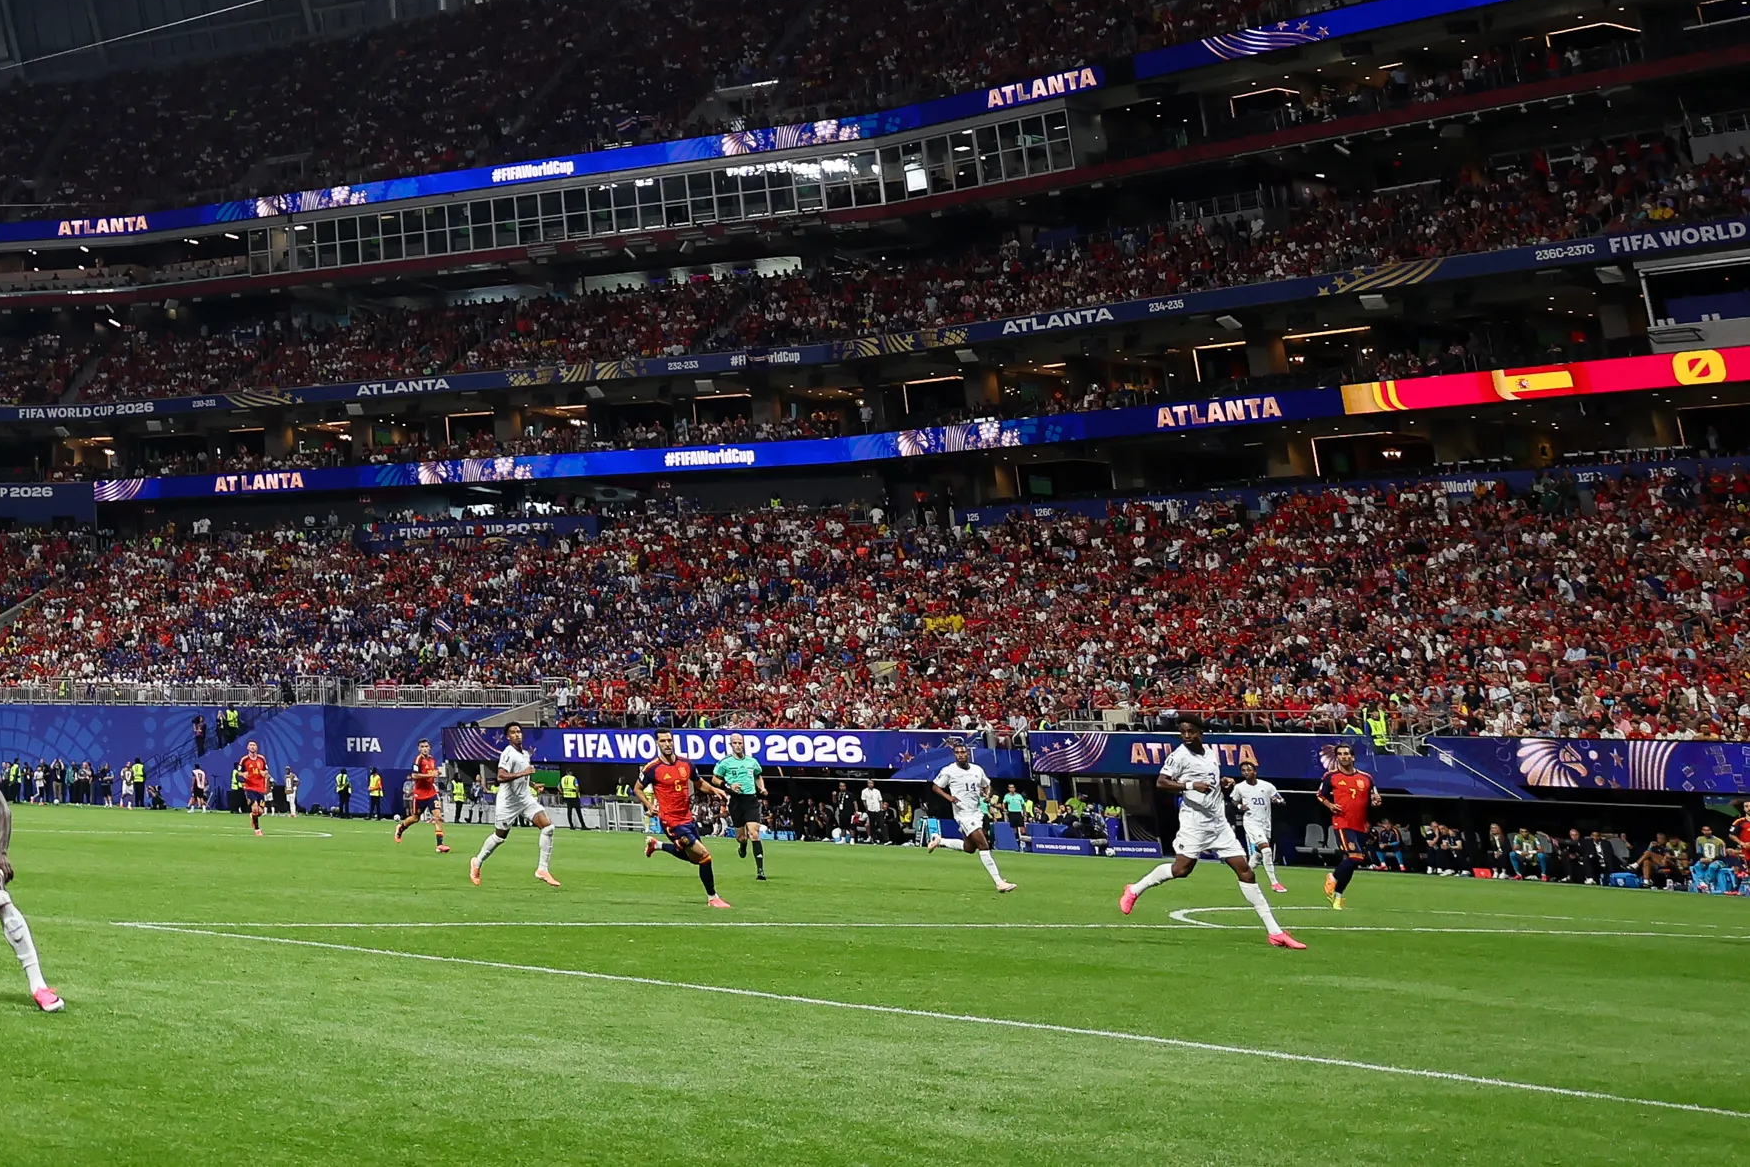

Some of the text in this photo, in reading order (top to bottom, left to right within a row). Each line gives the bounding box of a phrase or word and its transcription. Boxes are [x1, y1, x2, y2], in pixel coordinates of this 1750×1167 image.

[987, 67, 1097, 108] ATLANTA
[492, 160, 574, 182] #FIFAWorldCup
[58, 214, 148, 236] ATLANTA
[1608, 222, 1746, 253] FIFA WORLD
[1535, 244, 1595, 261] 236C-237C
[1002, 299, 1184, 334] ATLANTA 234-235
[668, 360, 699, 371] 232-233
[1672, 349, 1726, 386] 0
[356, 378, 449, 397] ATLANTA
[19, 402, 154, 419] FIFA WORLD CUP 2026
[1157, 396, 1282, 428] ATLANTA
[664, 448, 755, 467] #FIFAWorldCup
[214, 471, 304, 492] ATLANTA
[9, 486, 53, 497] 2026
[966, 512, 979, 522] 125
[347, 737, 381, 752] FIFA
[563, 734, 615, 758] FIFA
[616, 734, 705, 760] WOLD
[765, 735, 863, 763] 2026
[675, 780, 682, 791] 6
[965, 783, 976, 792] 14
[1350, 788, 1357, 799] 7
[1252, 798, 1265, 806] 20
